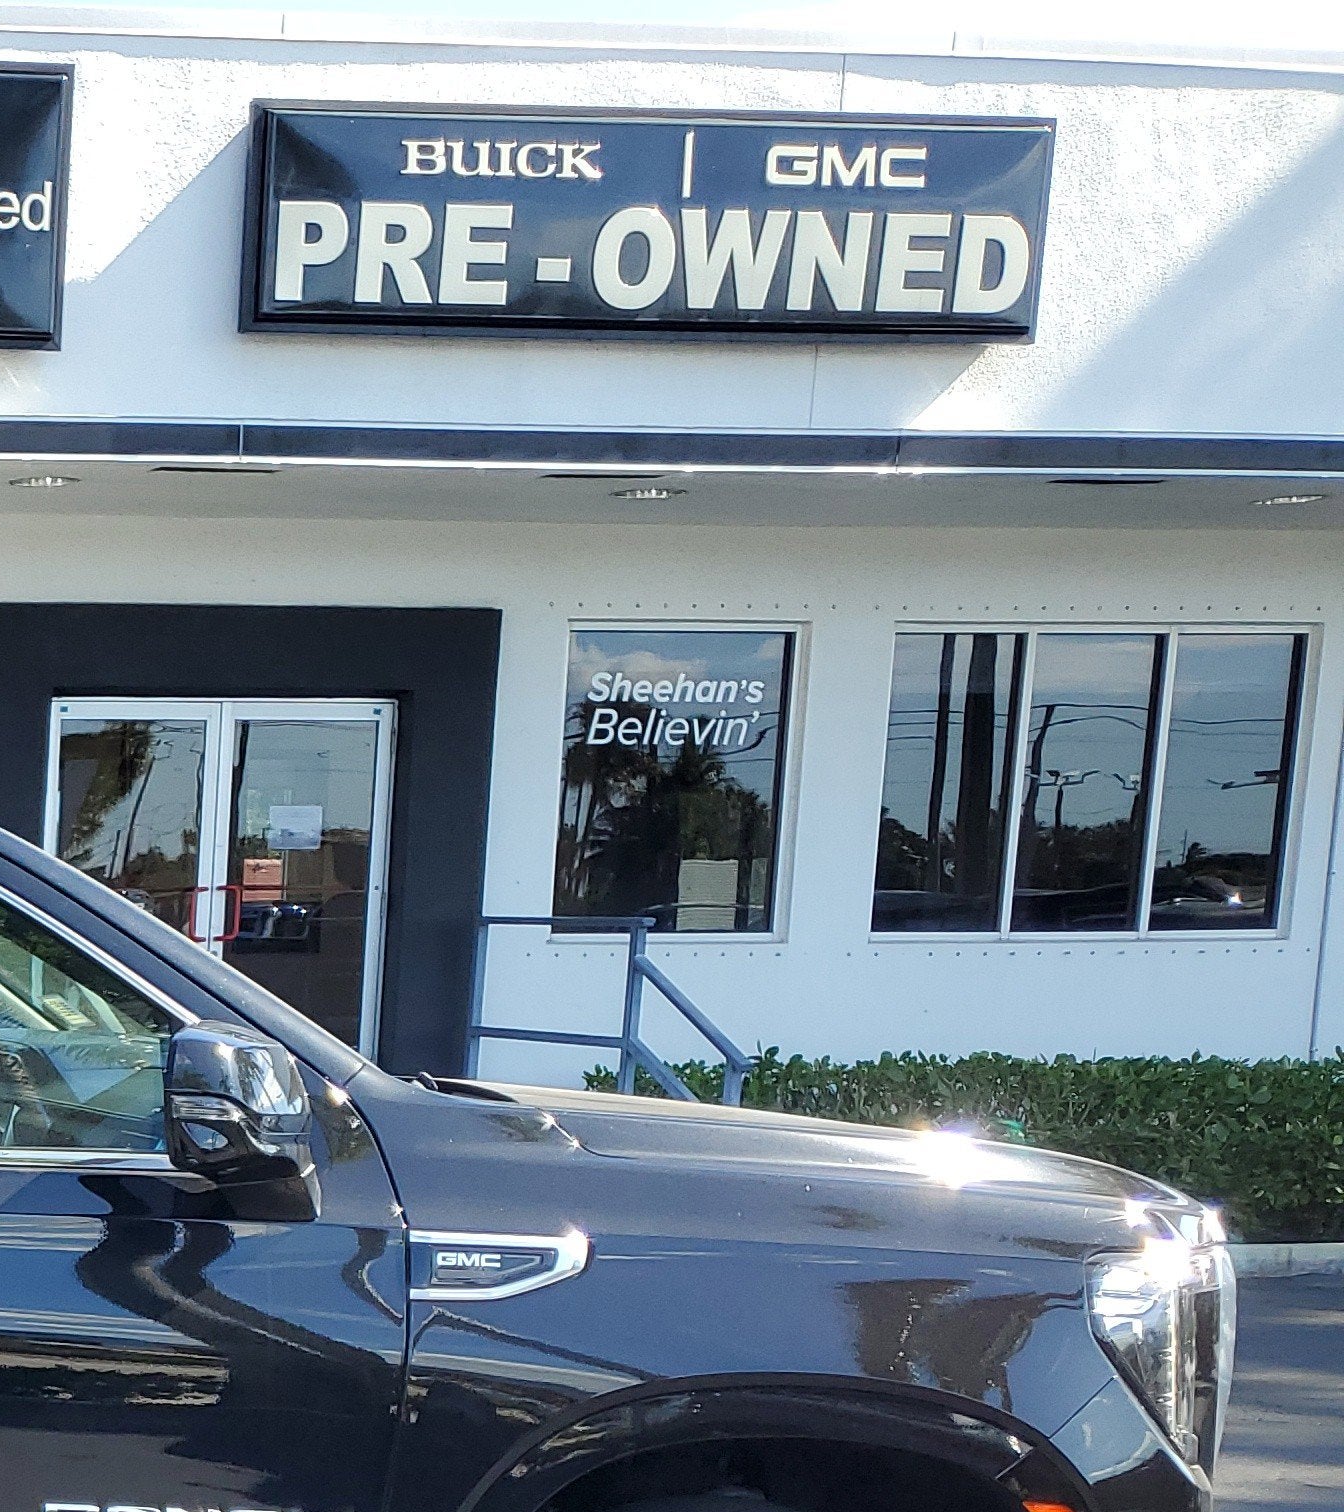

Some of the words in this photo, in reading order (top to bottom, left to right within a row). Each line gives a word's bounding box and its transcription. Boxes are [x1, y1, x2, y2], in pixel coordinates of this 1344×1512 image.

[400, 139, 603, 180] BUICK
[765, 145, 927, 188] GMC
[587, 671, 765, 704] Sheehan's
[586, 707, 761, 747] Believin'
[436, 1251, 502, 1269] GMC
